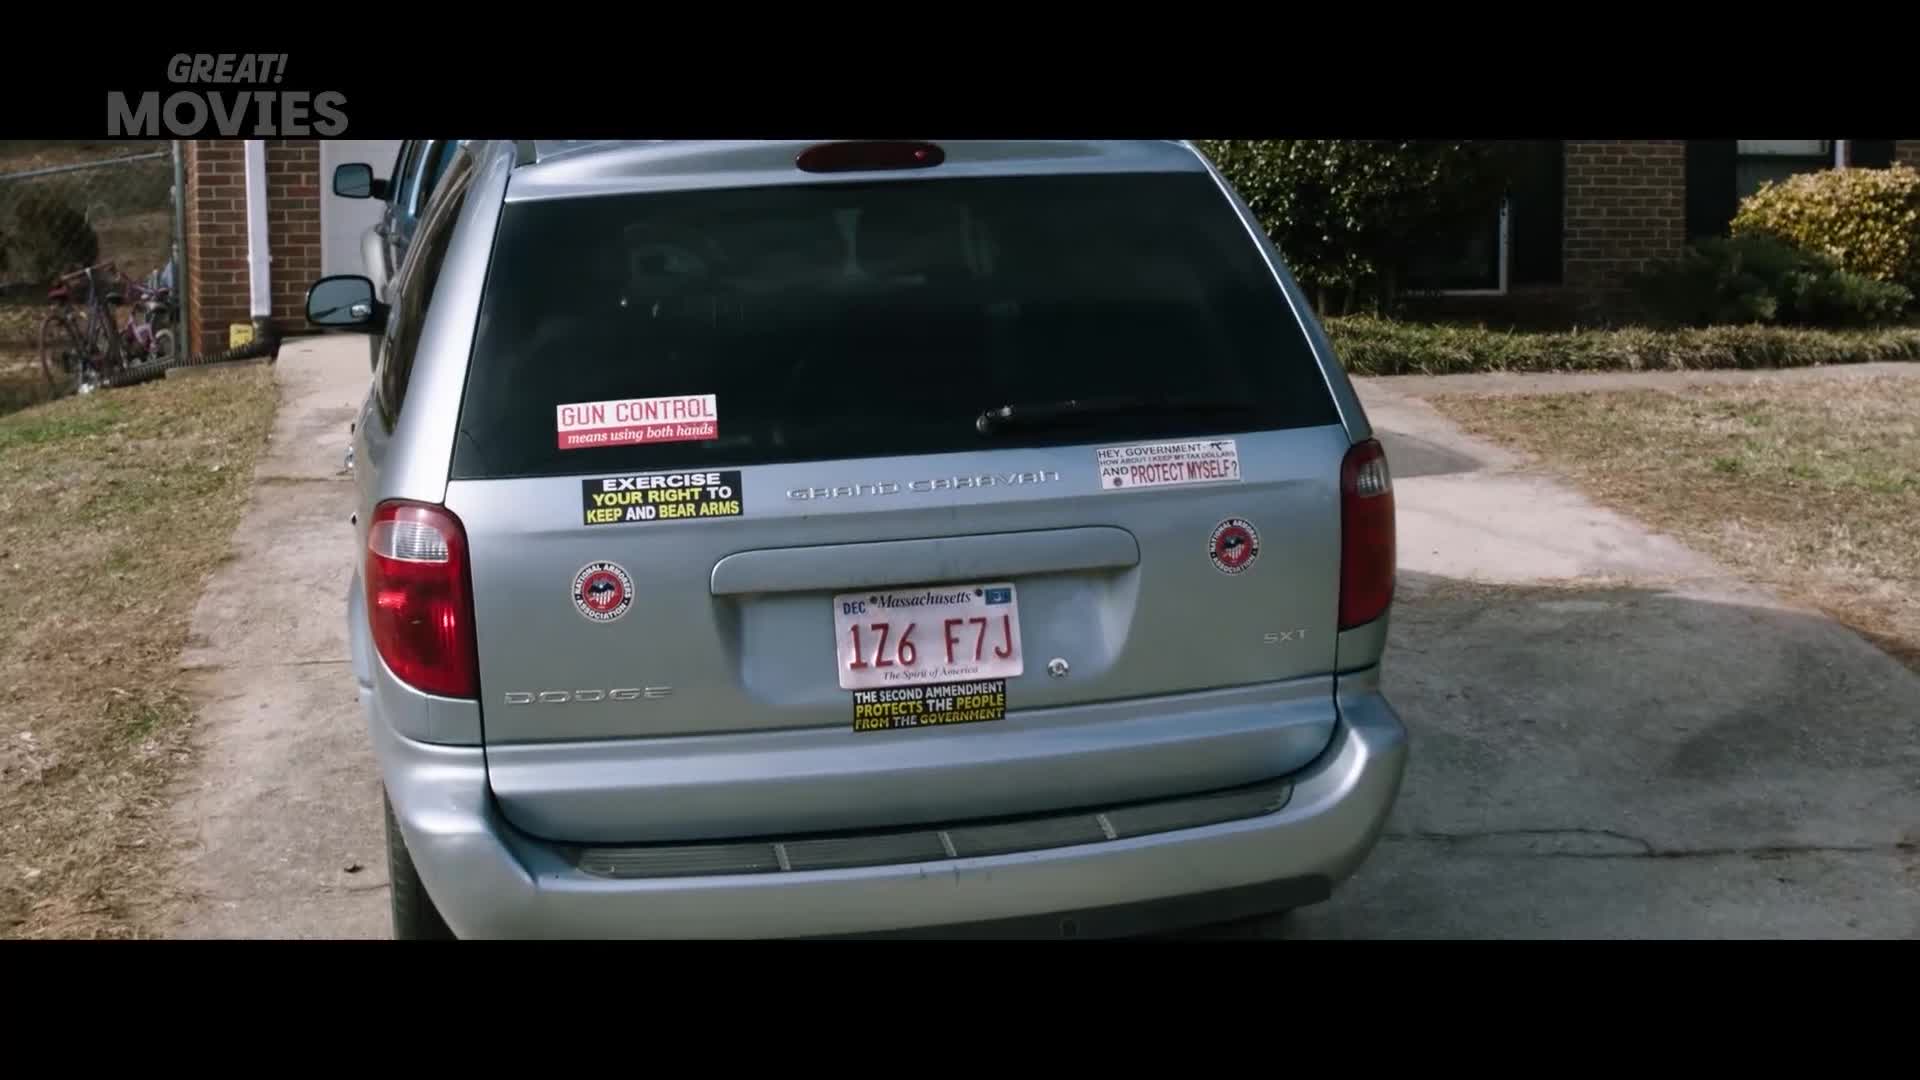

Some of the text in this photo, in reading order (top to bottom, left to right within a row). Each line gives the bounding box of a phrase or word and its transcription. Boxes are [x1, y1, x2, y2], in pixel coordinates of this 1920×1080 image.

[562, 399, 714, 427] GUN CONTROL
[568, 423, 713, 444] means using both hands
[1099, 449, 1124, 459] HEY,
[1100, 457, 1119, 465] HOW
[1121, 456, 1146, 464] ABOUT
[1152, 454, 1173, 462] KEEP
[1174, 453, 1185, 461] MY
[1187, 452, 1200, 460] TAX
[1202, 451, 1236, 459] DOLLARS
[603, 473, 720, 492] EXERCISE
[1102, 466, 1129, 477] AND
[1131, 462, 1184, 484] PROTECT
[786, 470, 1060, 500] GRAND CARAVAN
[592, 486, 732, 507] YOUR RIGHT TO
[586, 500, 740, 523] KEEP AND BEAR ARMS
[575, 564, 602, 594] NATIONAL
[577, 599, 627, 620] ASSOCIATION
[842, 601, 866, 615] DEC
[877, 591, 972, 609] Massachusetts
[850, 614, 1014, 671] 1Z6 F7J
[1264, 629, 1307, 643] SXT
[883, 665, 979, 682] The Spirit of America
[503, 686, 673, 704] DODGE
[855, 681, 1004, 704] THE SECOND AMMENDMENT
[856, 694, 1004, 717] PROTECTS THE PEOPLE
[855, 707, 1005, 730] FROM THE GOVERNMENT
